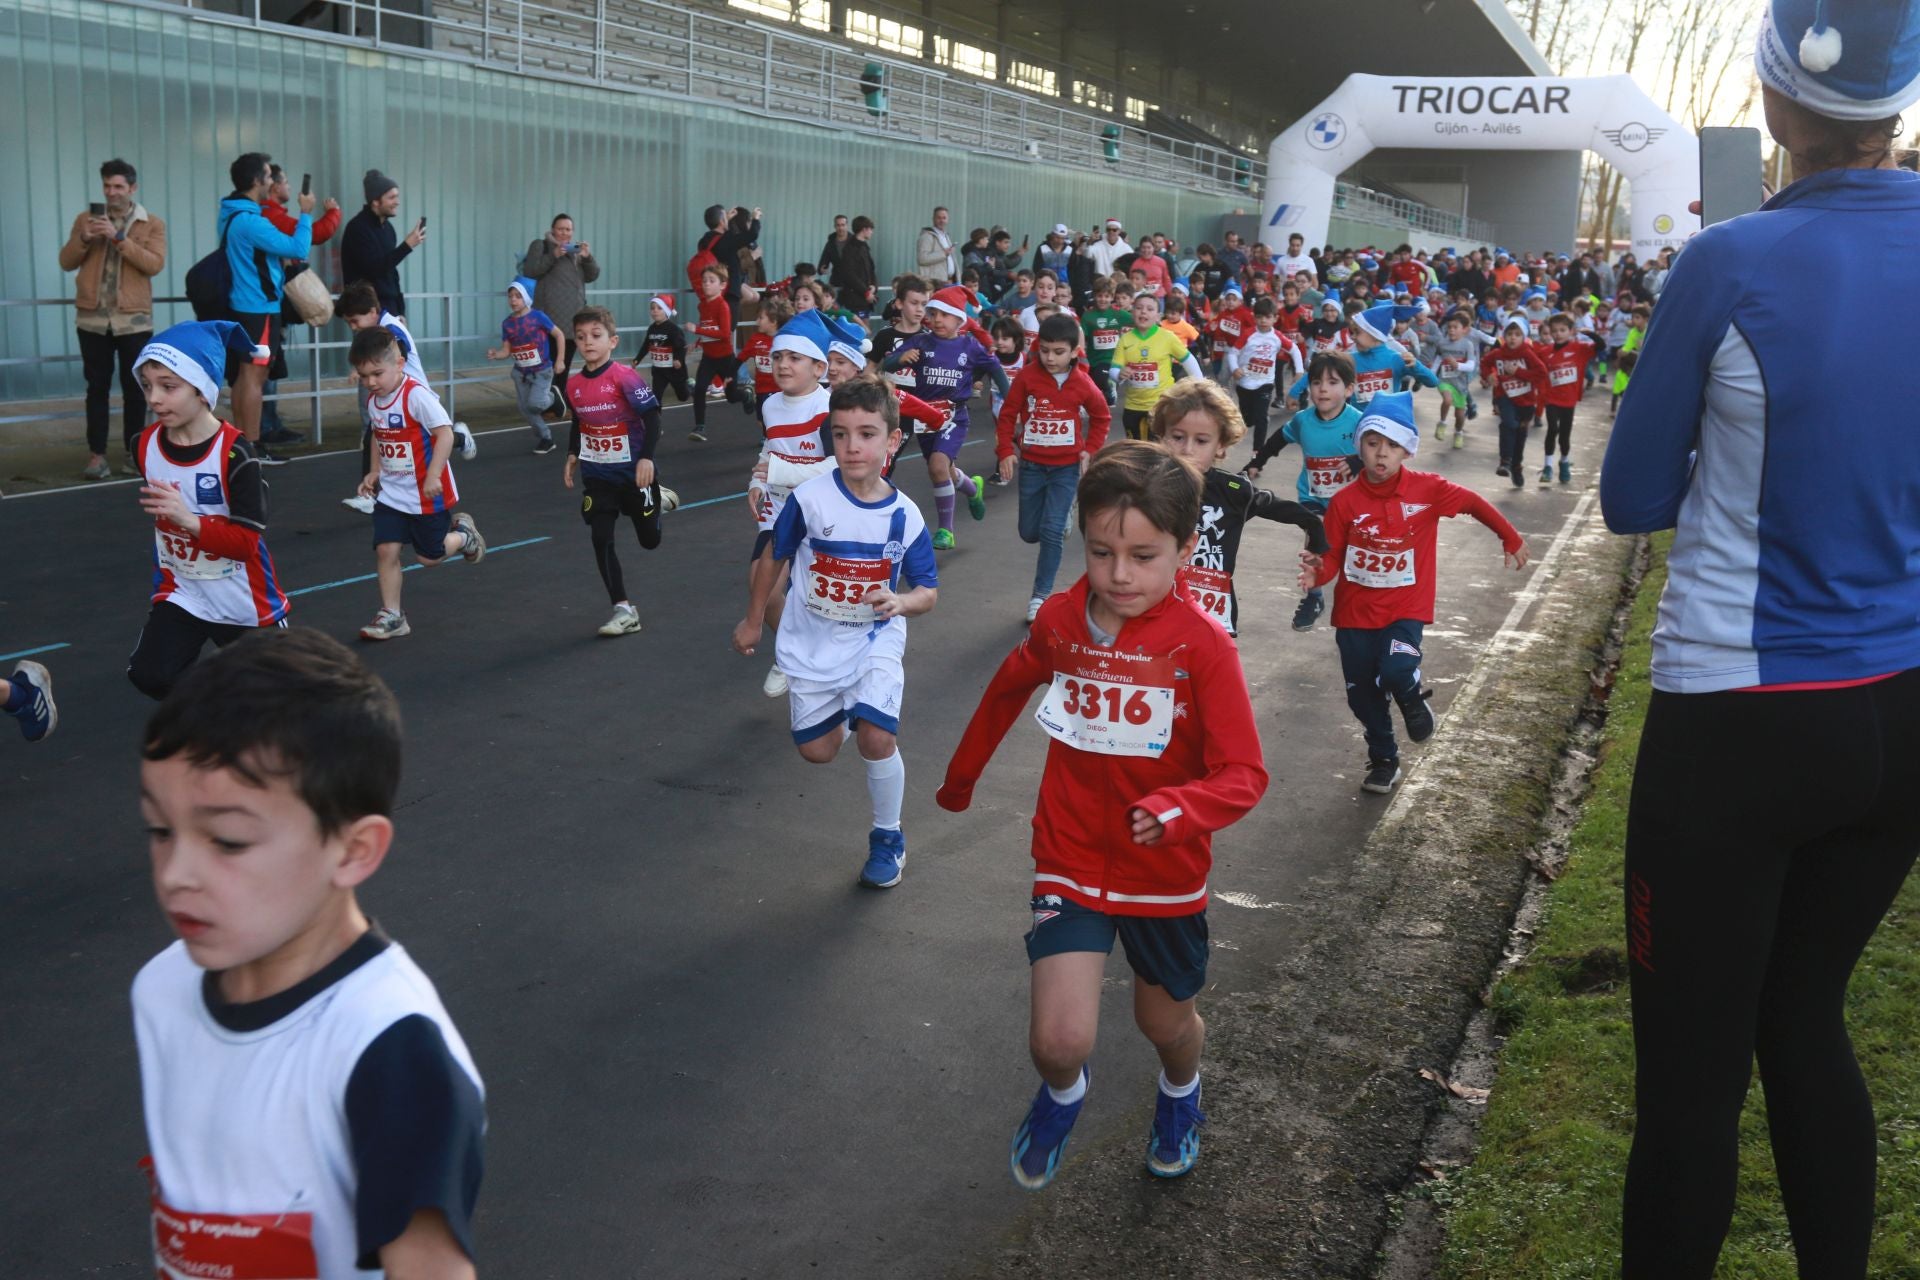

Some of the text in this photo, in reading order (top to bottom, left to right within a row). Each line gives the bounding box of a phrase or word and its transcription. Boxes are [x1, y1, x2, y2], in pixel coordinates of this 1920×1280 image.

[1392, 85, 1571, 114] TRIOCAR
[1434, 121, 1469, 135] Gijón
[1481, 120, 1521, 135] Avilés
[1622, 131, 1646, 141] MINI
[923, 366, 963, 379] Emirates
[927, 375, 957, 387] FLY BETTER
[1358, 380, 1389, 394] 3356
[1030, 421, 1069, 435] 3326
[585, 436, 623, 453] 3395
[1211, 544, 1223, 554] DE
[836, 559, 860, 569] Carrera
[861, 562, 882, 570] Popular
[1353, 550, 1408, 573] 3296
[1082, 645, 1113, 659] Carrera
[1114, 652, 1153, 663] Popular
[1098, 660, 1110, 669] de
[1076, 667, 1134, 684] Nochebuena
[1063, 679, 1153, 726] 3316
[1086, 723, 1108, 733] DIEGO
